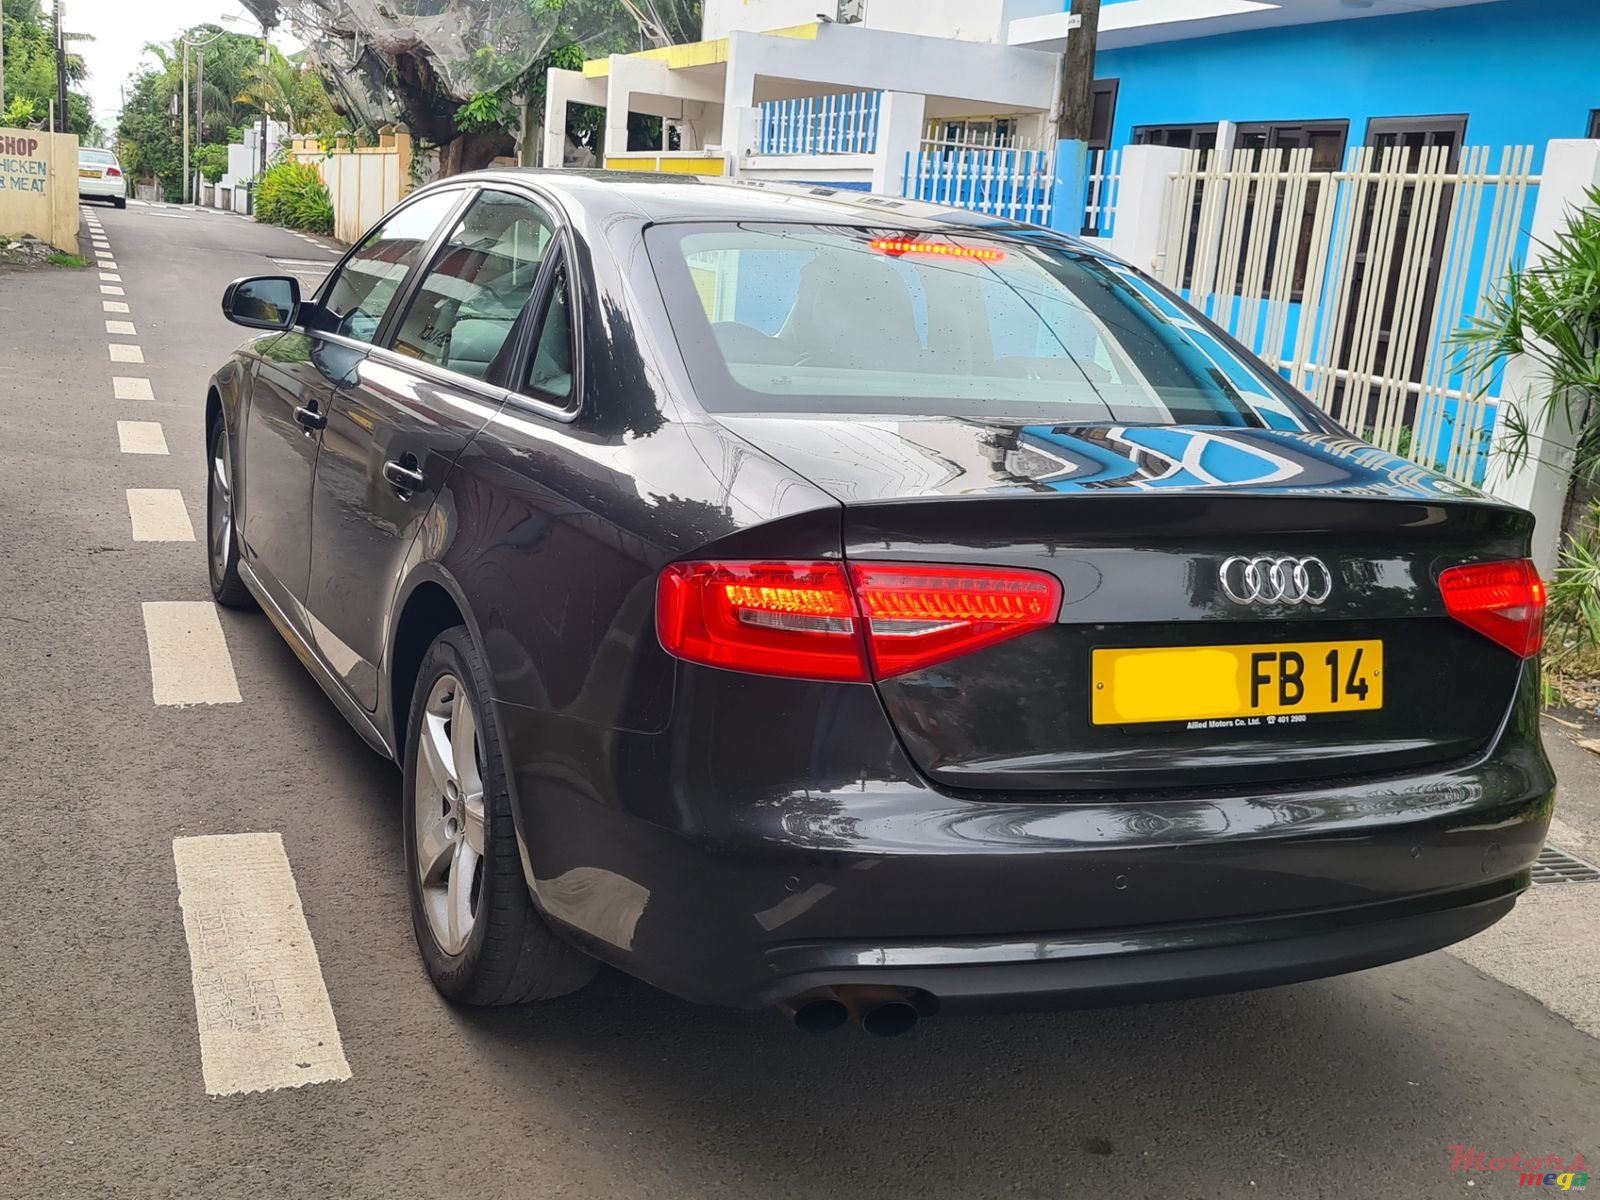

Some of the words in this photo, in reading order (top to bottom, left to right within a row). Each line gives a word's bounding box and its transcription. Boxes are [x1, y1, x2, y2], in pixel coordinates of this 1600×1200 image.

[10, 176, 46, 193] MEAT
[1251, 651, 1305, 708] FB
[1325, 648, 1369, 703] 14
[1208, 719, 1234, 729] Motors
[1234, 718, 1247, 727] Co.
[1247, 717, 1262, 726] Ltd.
